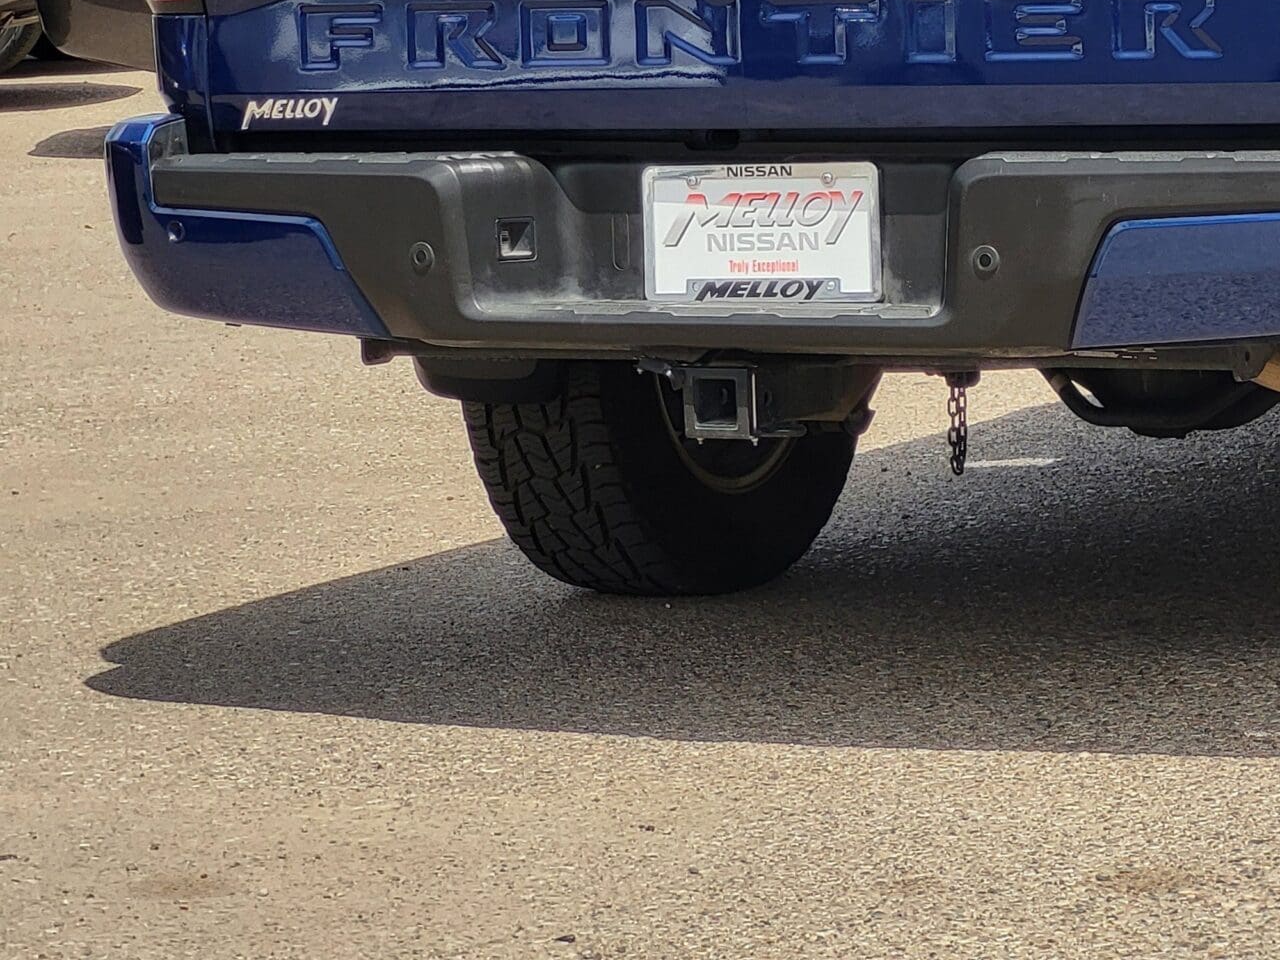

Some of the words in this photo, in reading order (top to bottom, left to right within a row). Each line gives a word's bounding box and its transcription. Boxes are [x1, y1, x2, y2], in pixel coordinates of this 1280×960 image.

[241, 96, 340, 131] MELLOY
[726, 165, 792, 178] NISSAN
[663, 190, 864, 247] MELLOY
[706, 232, 820, 252] NISSAN
[728, 259, 750, 274] Truly
[752, 259, 799, 273] Exceptional
[694, 280, 824, 301] MELLOY
